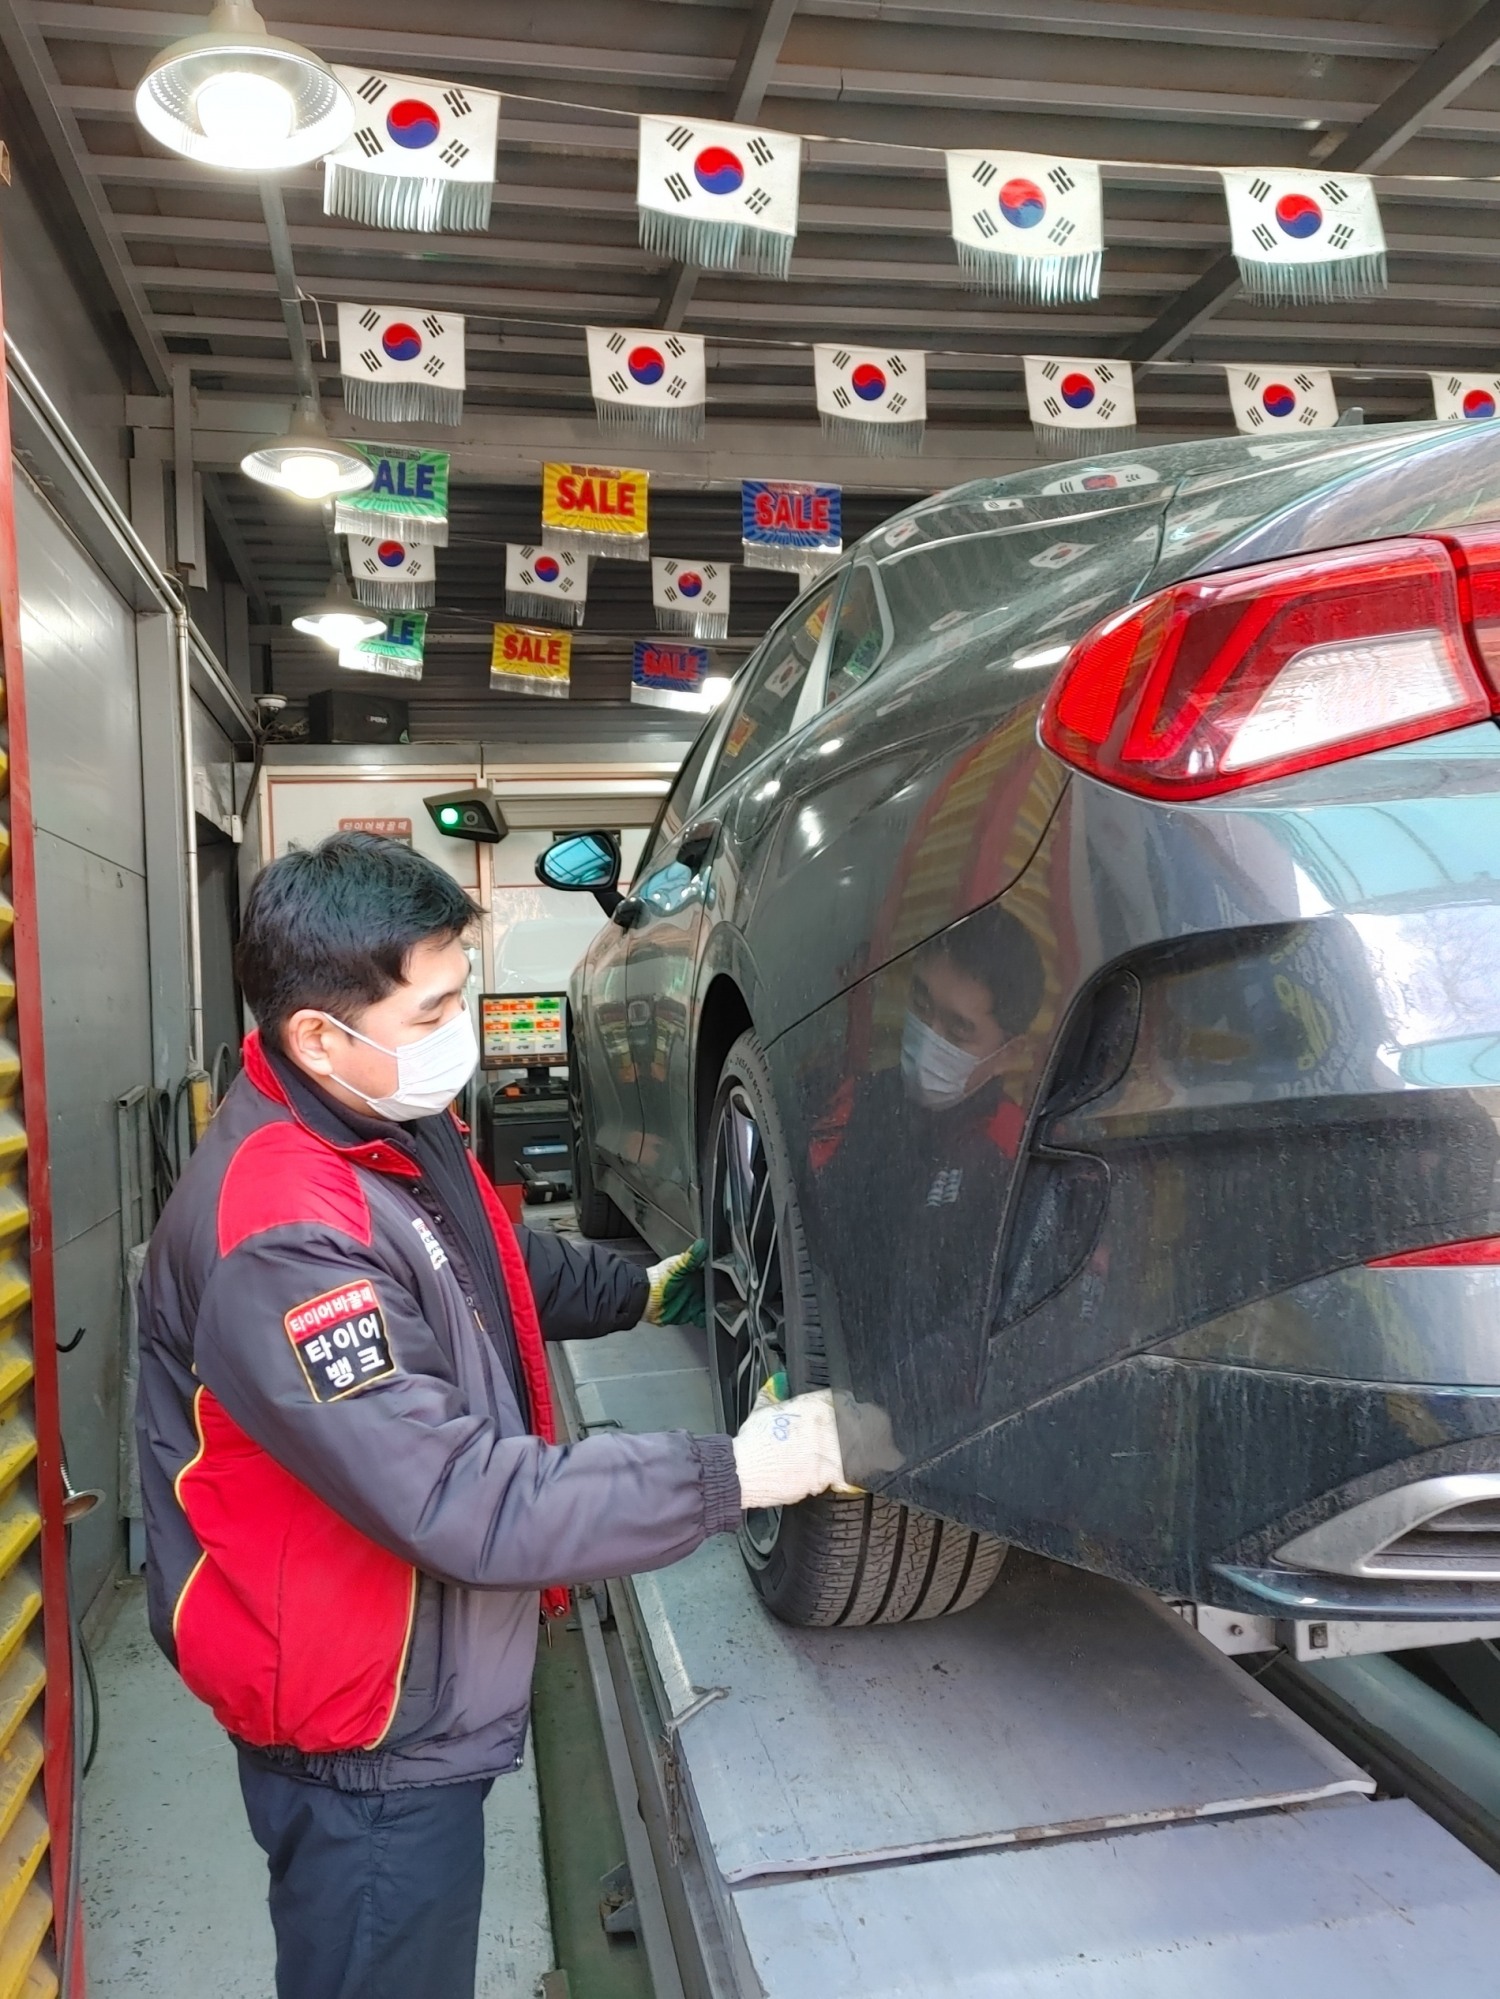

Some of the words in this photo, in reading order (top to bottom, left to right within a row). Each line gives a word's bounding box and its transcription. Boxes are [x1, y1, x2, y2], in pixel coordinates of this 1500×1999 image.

[372, 459, 436, 500] ALE
[556, 474, 636, 517] SALE
[754, 492, 831, 533] SALE
[503, 633, 563, 666] SALE
[642, 649, 700, 681] SALE
[304, 1313, 381, 1364] 타이어
[324, 1345, 386, 1389] 뱅크
